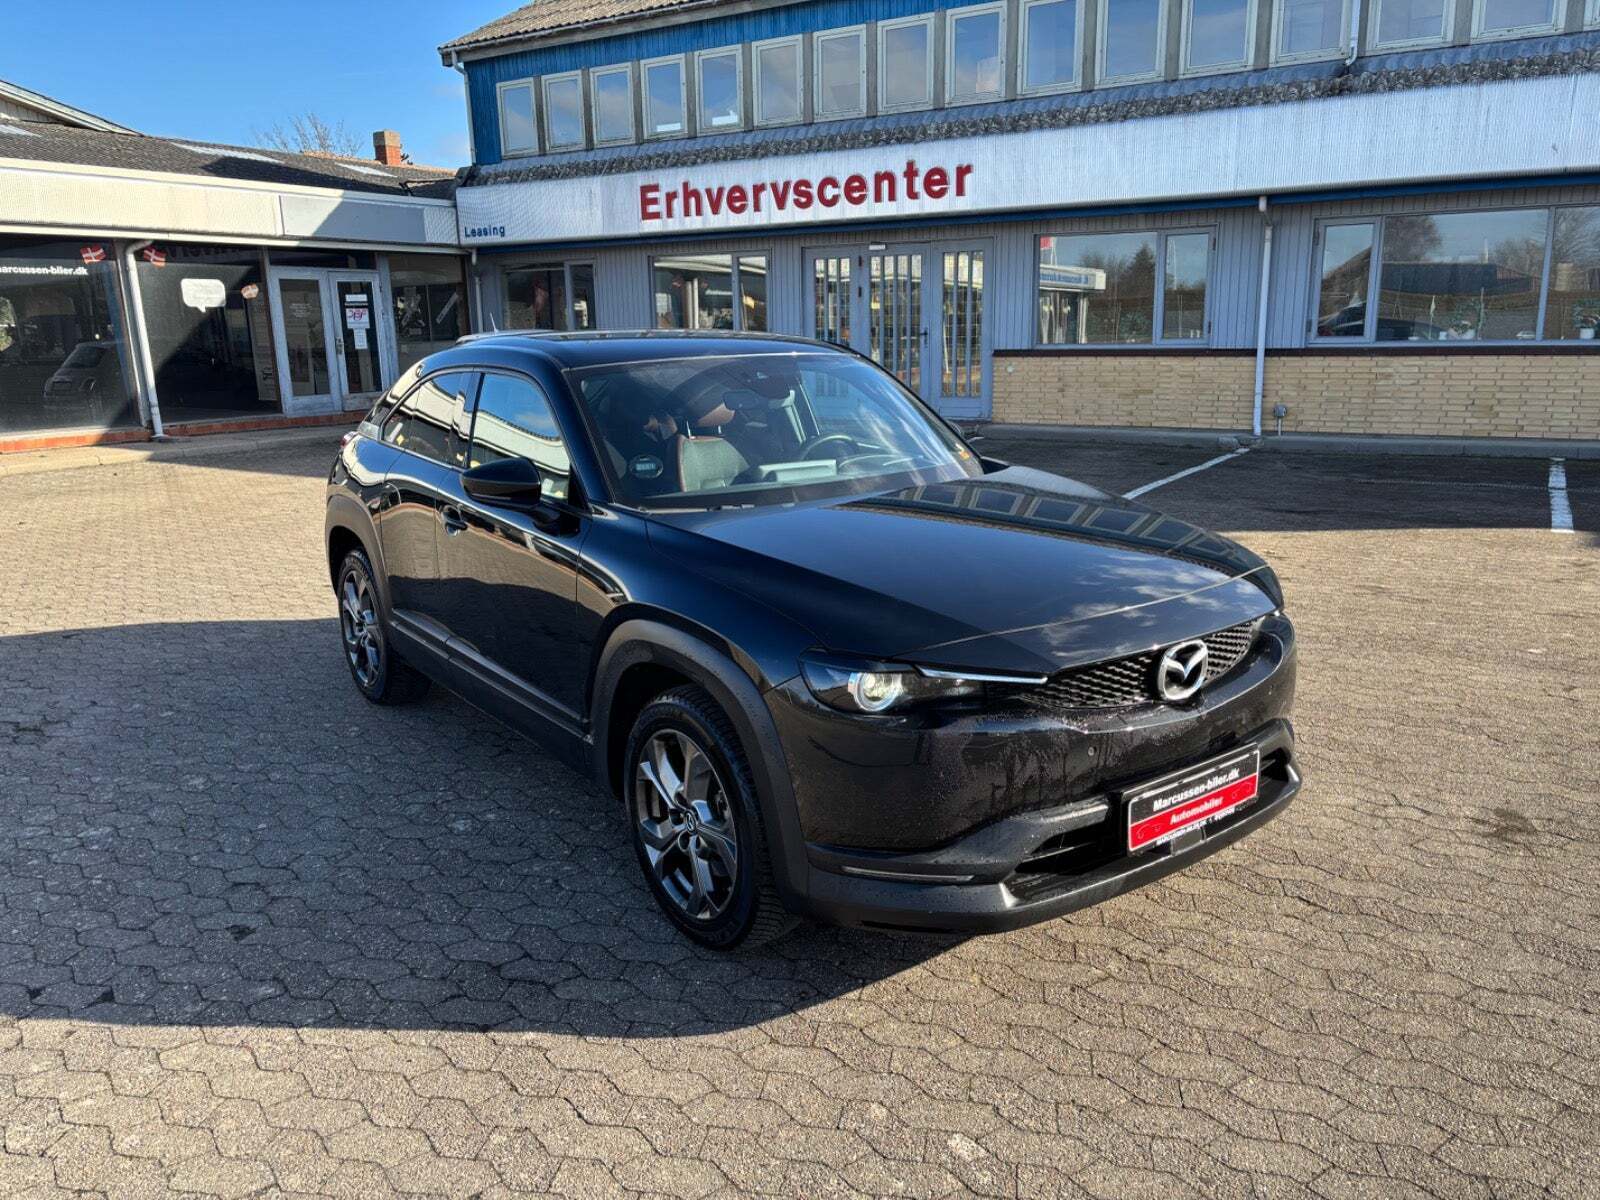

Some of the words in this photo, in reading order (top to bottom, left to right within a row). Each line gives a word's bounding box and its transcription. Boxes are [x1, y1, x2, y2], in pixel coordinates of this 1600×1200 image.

[640, 159, 974, 221] Erhvervscenter
[464, 224, 506, 238] Leasing
[0, 265, 88, 276] arcussen-biler.dk
[1153, 767, 1240, 812] Marcussen-biler.dk
[1169, 796, 1225, 826] Automobiler
